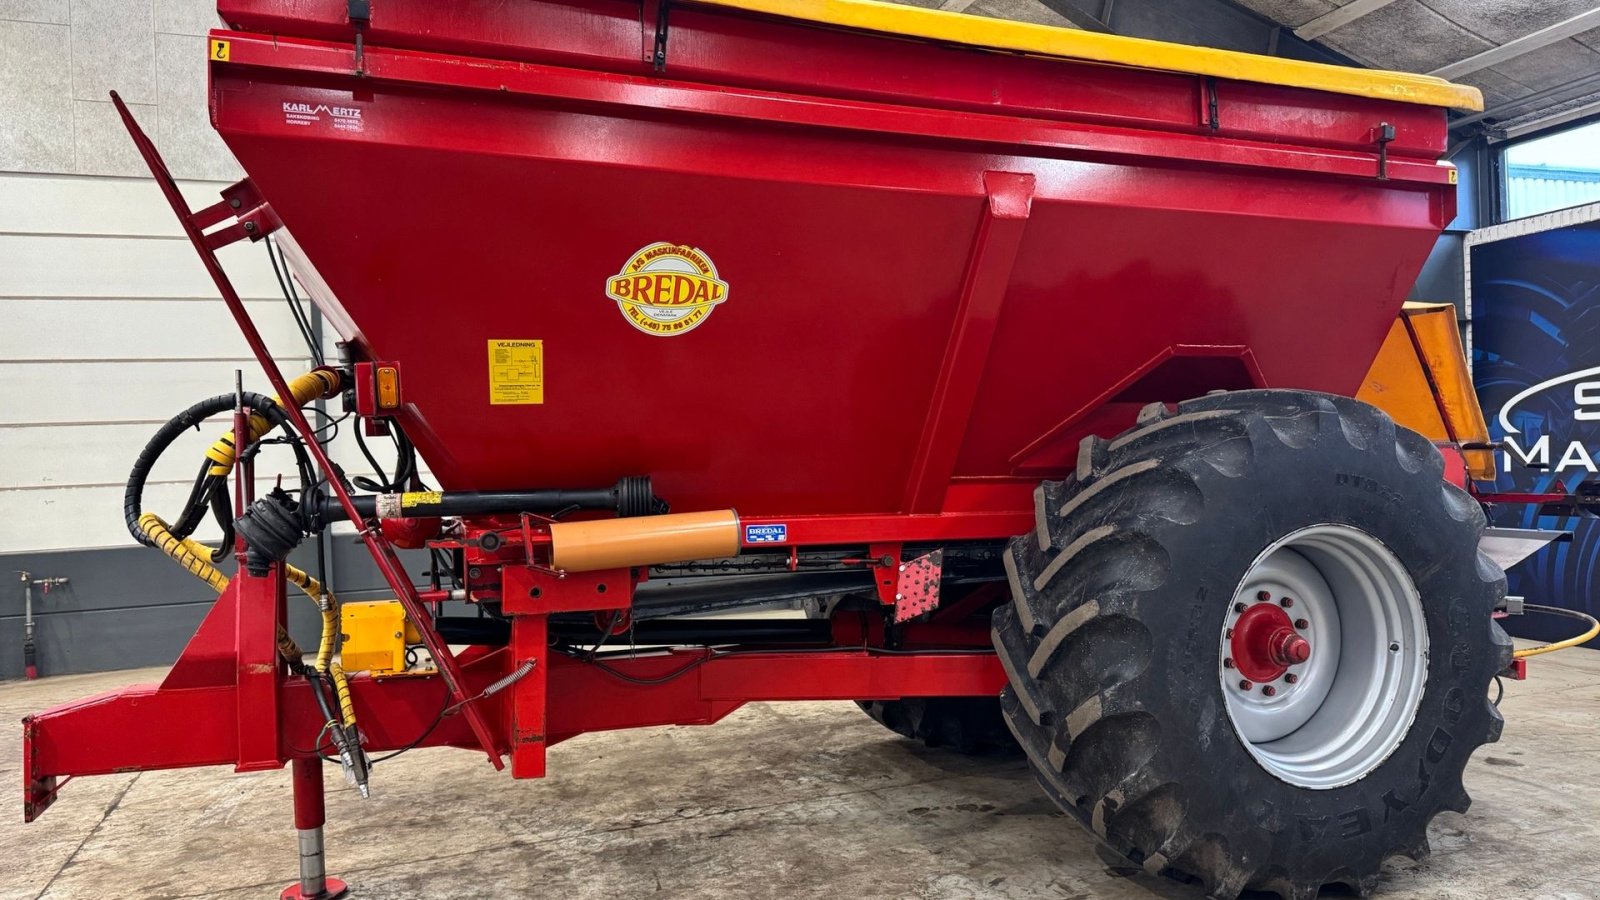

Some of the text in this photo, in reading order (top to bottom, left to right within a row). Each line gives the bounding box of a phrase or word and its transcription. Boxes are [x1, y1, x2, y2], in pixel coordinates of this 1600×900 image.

[283, 102, 313, 112] KARL
[631, 246, 710, 275] A/S MASKINFABRIKEN
[614, 274, 721, 306] BREDAL
[693, 309, 703, 319] 77
[749, 527, 785, 535] BREDAL
